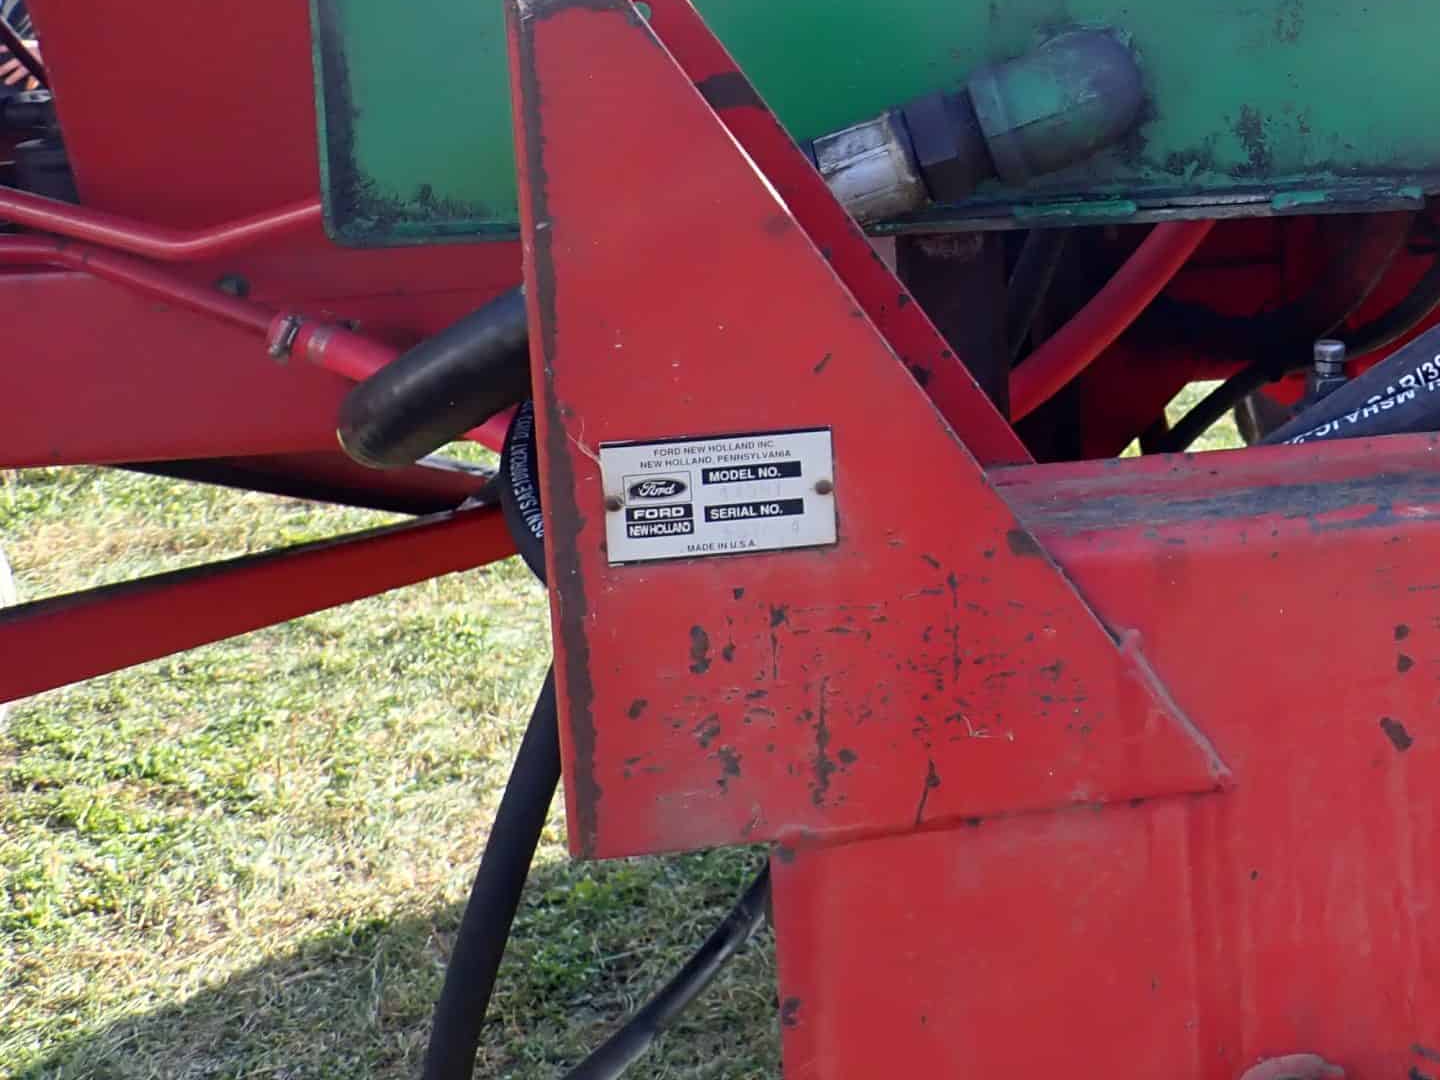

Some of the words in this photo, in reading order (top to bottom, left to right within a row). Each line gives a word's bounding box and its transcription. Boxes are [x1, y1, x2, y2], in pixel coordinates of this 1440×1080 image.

[653, 447, 681, 457] FORD
[683, 446, 706, 455] NEW
[708, 441, 755, 453] HOLLAND
[640, 460, 661, 469] NEW
[717, 450, 791, 463] PENNSYLVANIA
[709, 468, 755, 482] MODEL
[758, 466, 781, 478] NO.
[639, 481, 676, 497] Ford
[633, 506, 684, 520] FORD
[710, 506, 757, 520] SERIAL
[760, 503, 783, 516] NO.
[687, 543, 715, 552] MADE
[717, 542, 727, 550] IN
